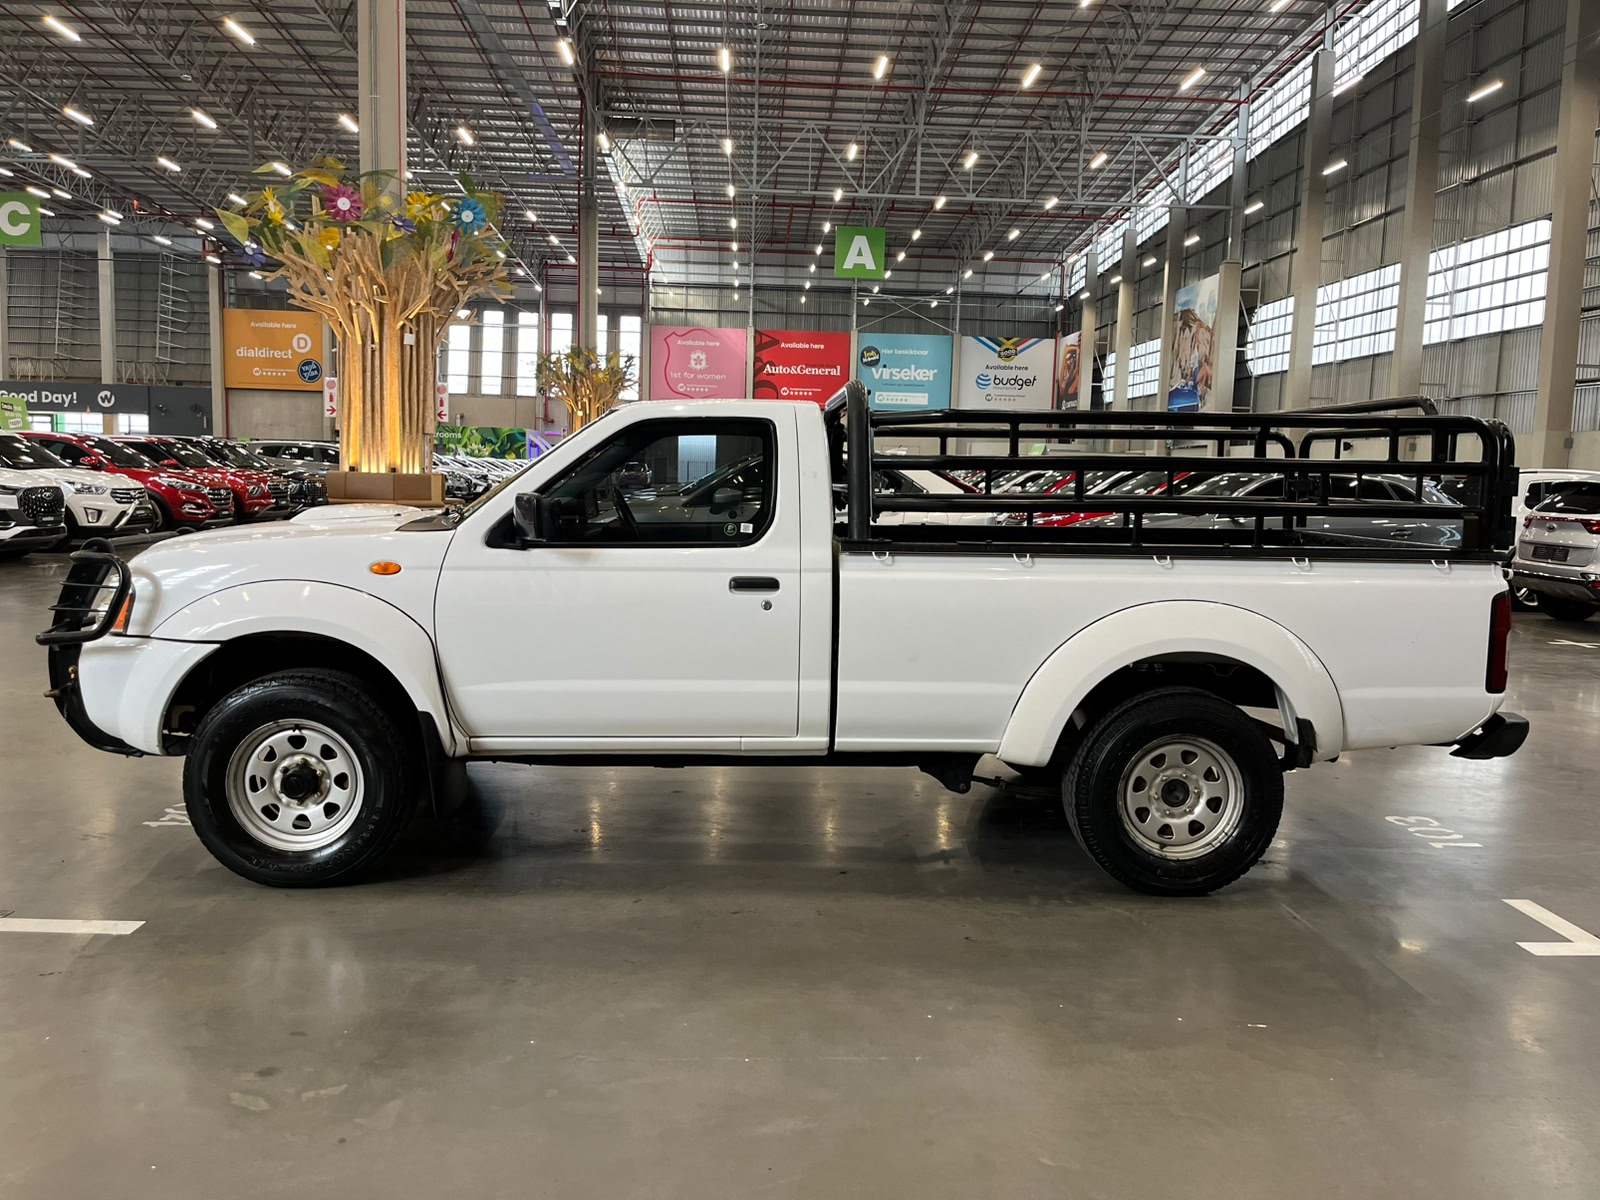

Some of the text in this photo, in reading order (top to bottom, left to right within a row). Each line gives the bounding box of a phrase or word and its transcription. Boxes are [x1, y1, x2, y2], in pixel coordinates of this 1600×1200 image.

[0, 200, 31, 236] C
[842, 235, 877, 270] A
[250, 321, 281, 329] Available
[236, 346, 293, 360] dialdirect
[670, 371, 683, 379] 1st
[763, 363, 841, 376] Auto&General
[871, 364, 938, 381] virseker
[993, 375, 1037, 391] budget
[41, 391, 77, 408] Day!
[1384, 816, 1483, 848] 103
